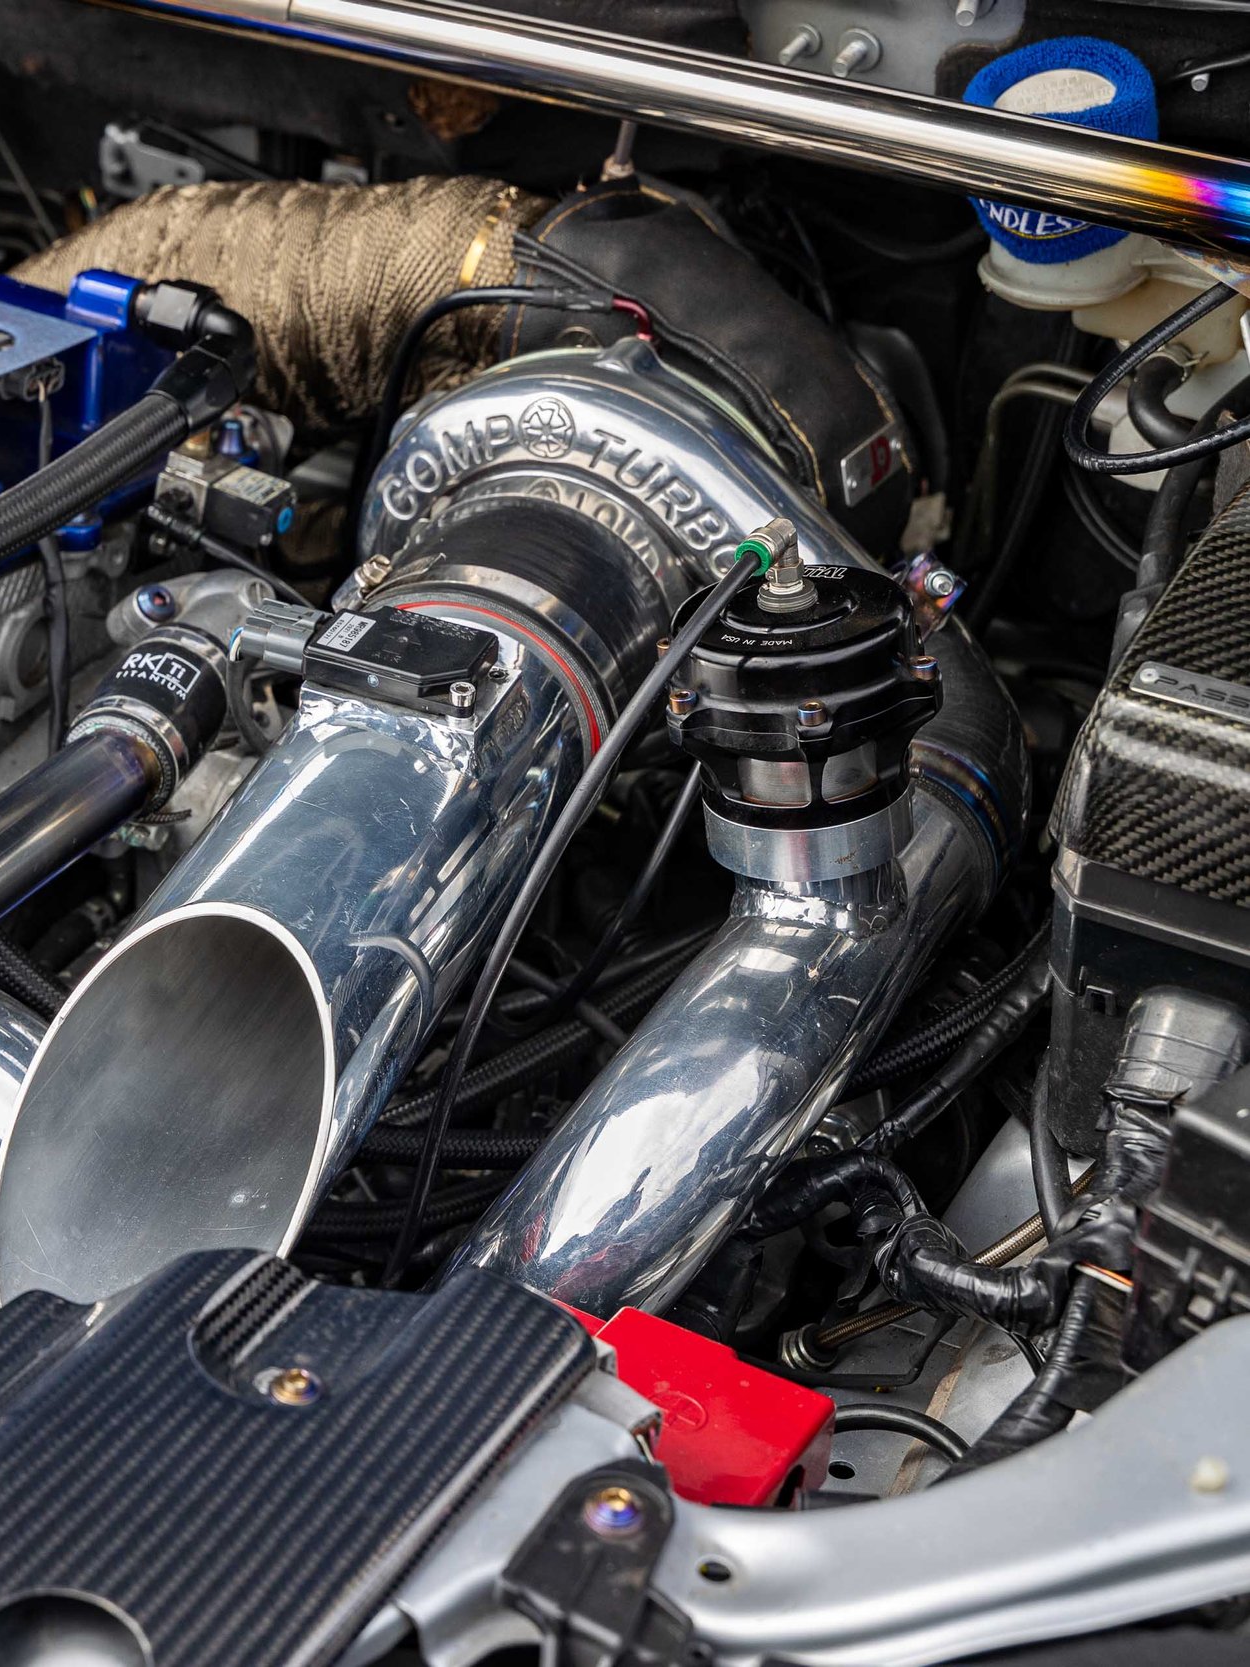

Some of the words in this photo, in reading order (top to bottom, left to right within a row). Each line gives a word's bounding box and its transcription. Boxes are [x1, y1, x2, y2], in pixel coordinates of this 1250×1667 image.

[382, 414, 516, 521] COMP
[720, 633, 740, 644] USA
[742, 638, 756, 646] IN
[760, 638, 793, 647] MADE
[122, 652, 164, 671] RK
[115, 669, 187, 701] TITANIUM
